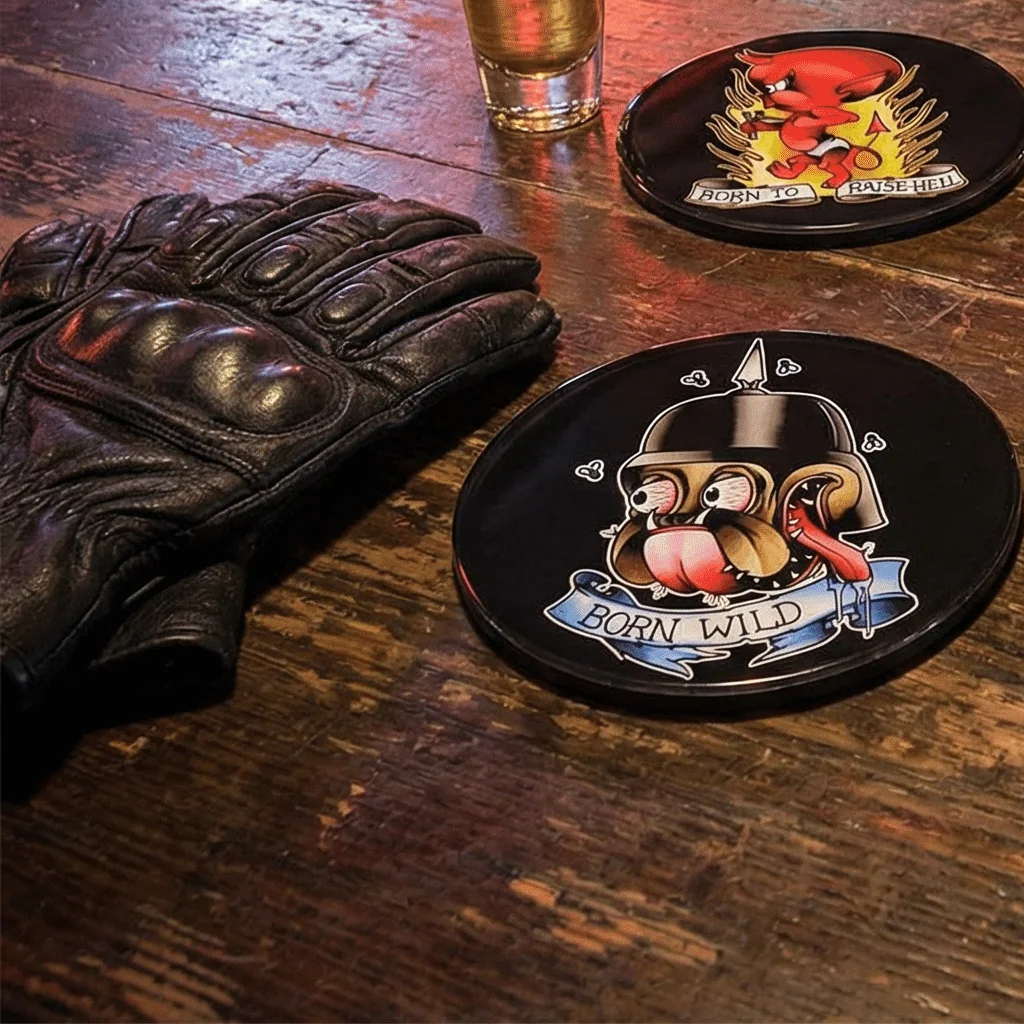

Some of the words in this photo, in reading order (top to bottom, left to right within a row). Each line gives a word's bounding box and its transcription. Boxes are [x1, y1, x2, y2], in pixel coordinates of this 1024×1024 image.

[699, 189, 760, 204] BORN
[771, 187, 799, 198] TO
[577, 603, 679, 643] BORN
[700, 601, 801, 640] WILD
